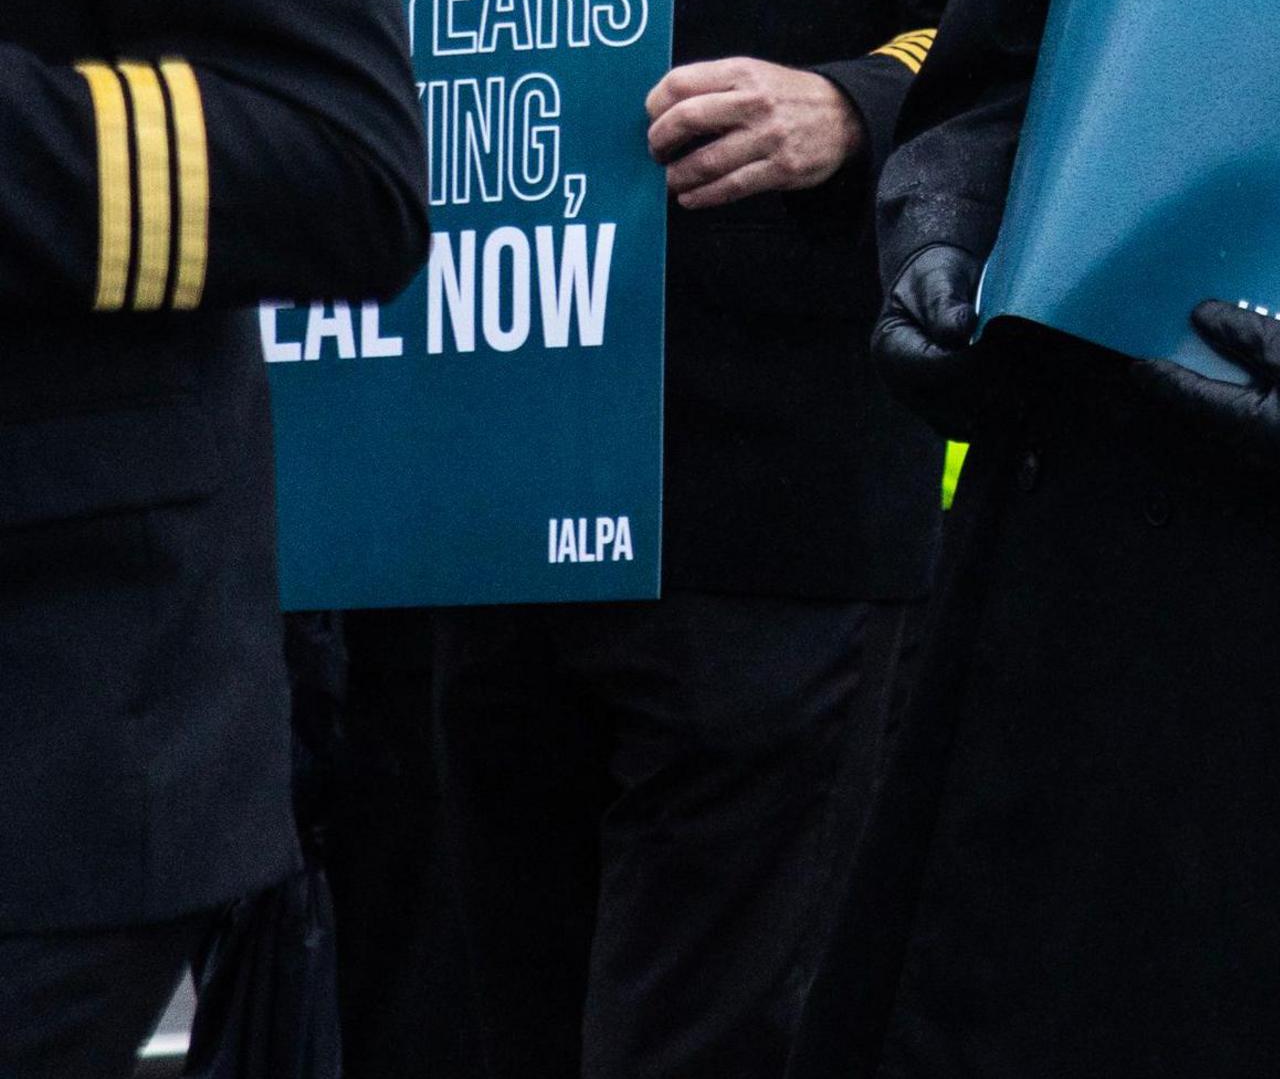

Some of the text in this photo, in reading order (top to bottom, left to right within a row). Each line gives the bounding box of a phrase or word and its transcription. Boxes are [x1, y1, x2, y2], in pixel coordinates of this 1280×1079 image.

[416, 73, 587, 218] ING,
[258, 223, 616, 363] EAL NOW
[548, 516, 634, 563] IALPA
